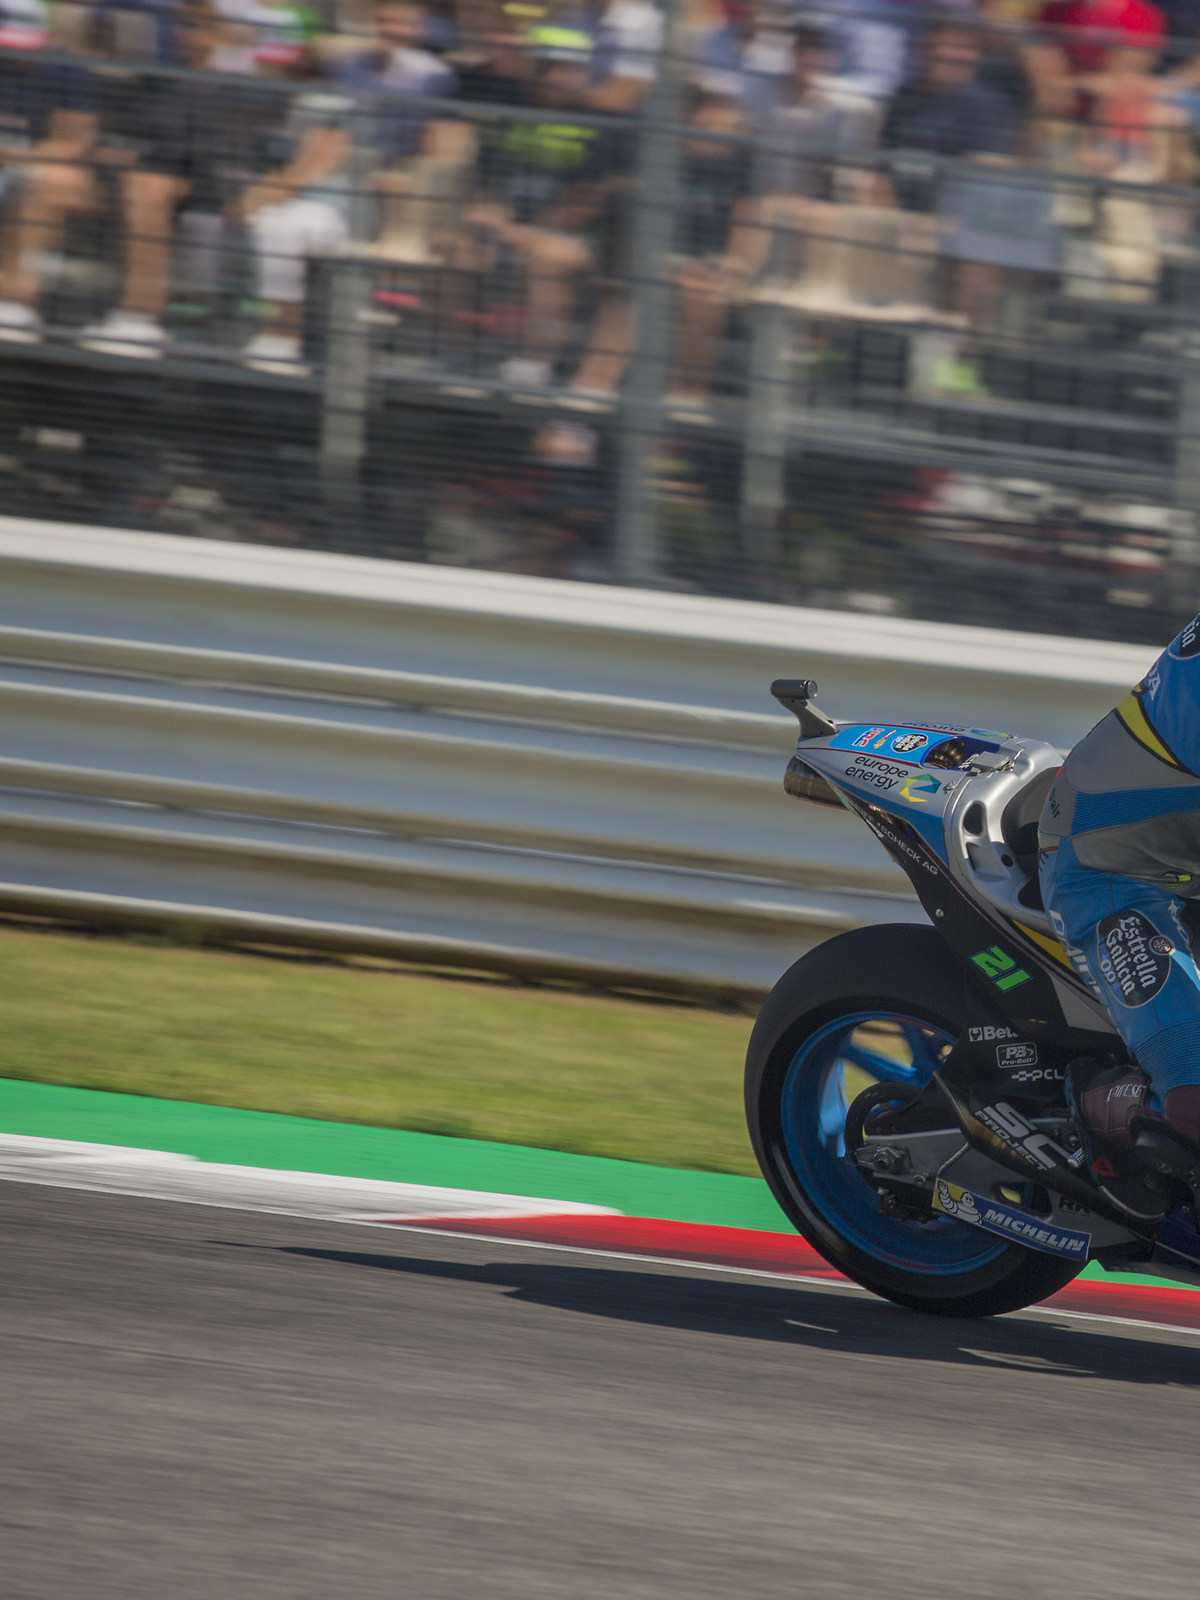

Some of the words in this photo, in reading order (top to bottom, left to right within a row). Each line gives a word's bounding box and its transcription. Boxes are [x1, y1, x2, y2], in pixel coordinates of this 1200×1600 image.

[845, 765, 900, 791] energy
[854, 755, 909, 779] europe
[970, 944, 1033, 992] 21
[1106, 928, 1135, 996] Galicia
[1119, 916, 1158, 988] Estrella
[1001, 1057, 1032, 1066] Pro-Bolt
[1006, 1045, 1027, 1059] PB
[974, 1109, 1048, 1171] PROJECT
[984, 1208, 1085, 1252] MICHELIN
